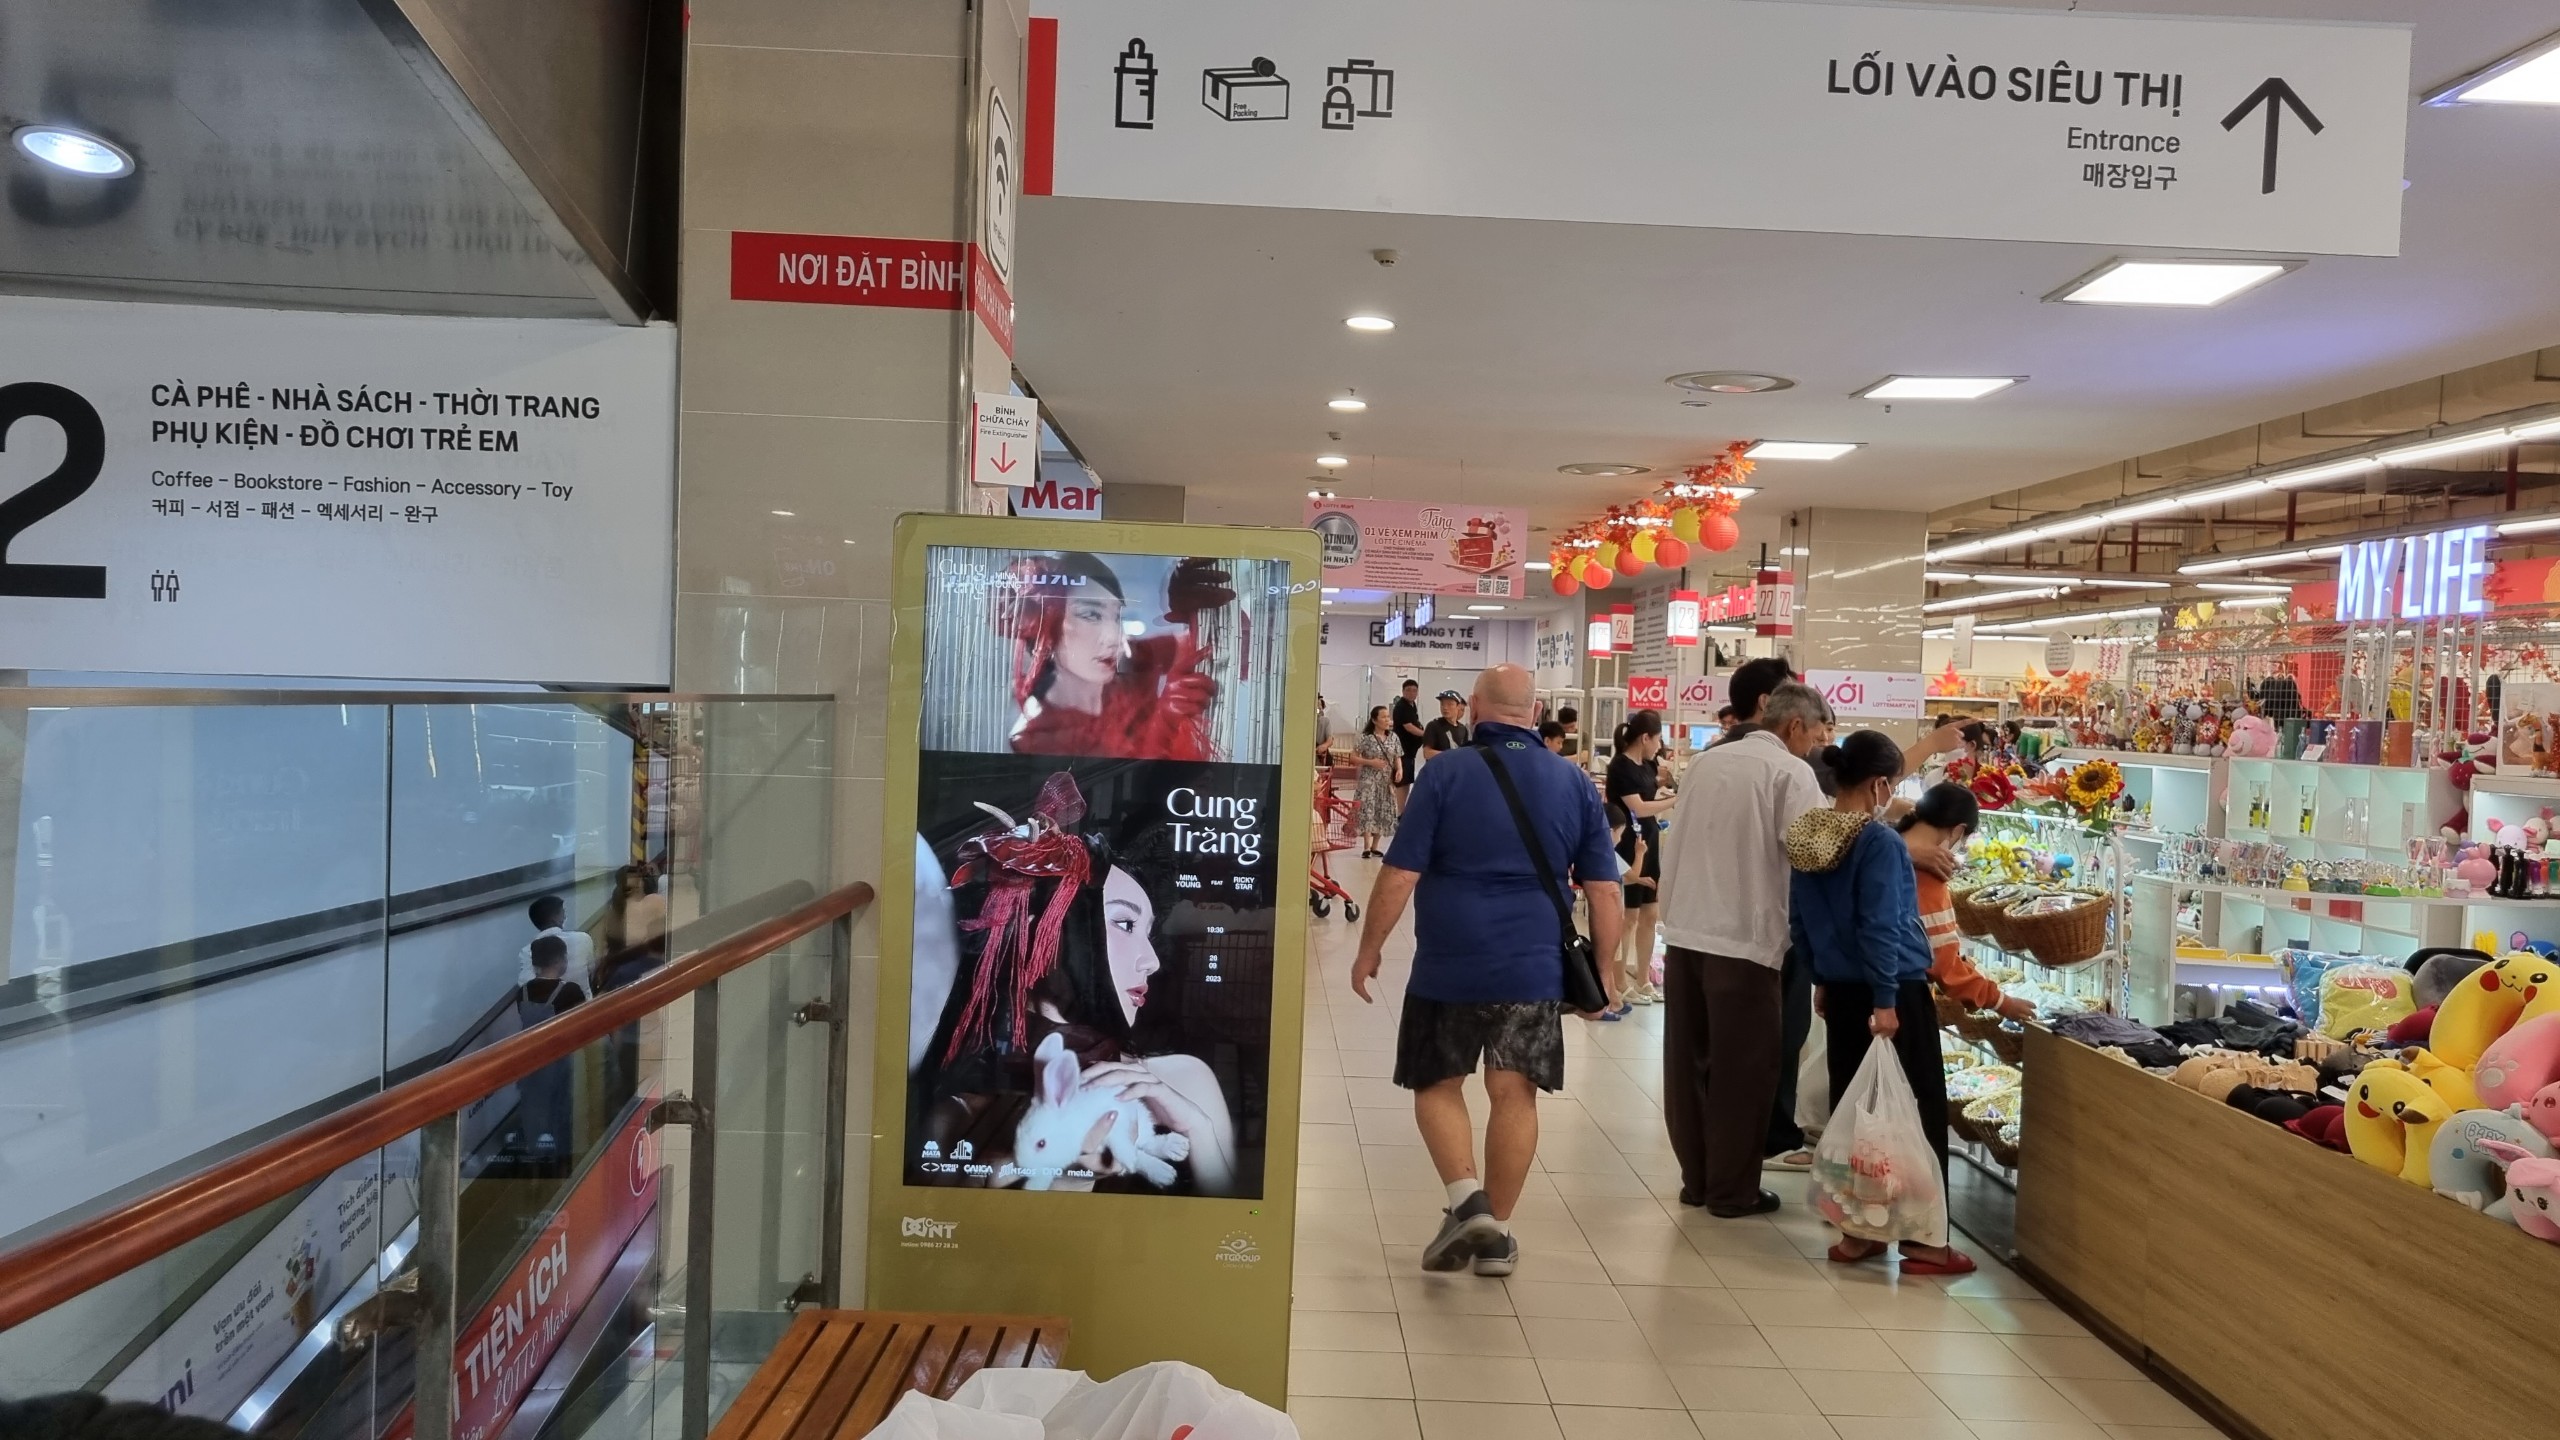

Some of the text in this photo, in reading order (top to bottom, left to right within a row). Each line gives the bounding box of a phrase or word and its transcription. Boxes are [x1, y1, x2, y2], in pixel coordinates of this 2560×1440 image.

[1827, 50, 2183, 118] LỐI VÀO SIÊU THỊ
[2067, 127, 2181, 154] Entrance
[2082, 163, 2178, 191] 매장입구
[779, 251, 964, 295] NƠI ĐẶT BÌNH
[151, 378, 191, 407] CÀ
[197, 381, 251, 409] PHÊ
[272, 383, 331, 411] NHÀ
[337, 384, 412, 413] SÁCH
[433, 387, 498, 416] THỜI
[505, 394, 600, 420] TRANG
[995, 405, 1015, 416] BÌNH
[980, 415, 1030, 427] CHỮA CHÁY
[152, 420, 208, 449] PHỤ
[216, 417, 278, 450] KIỆN
[299, 418, 339, 448] ĐỒ
[346, 426, 413, 450] CHƠI
[421, 423, 471, 451] TRẺ
[479, 430, 519, 452] EM
[0, 381, 107, 599] 2
[151, 470, 213, 488] Coffee
[234, 473, 323, 490] Bookstore
[344, 476, 410, 493] Fashion
[431, 479, 521, 499] Accessory
[541, 481, 573, 501] Toy
[151, 499, 184, 517] 커피
[206, 500, 239, 518] 서점
[261, 502, 295, 520] 패션
[317, 503, 383, 522] 엑세서리
[404, 505, 438, 523] 완구
[1419, 508, 1456, 539] Tặng
[1324, 533, 1354, 545] ATINUM
[1364, 527, 1375, 536] 01
[1391, 529, 1412, 538] XEM
[1413, 530, 1438, 539] PHIM
[1398, 539, 1427, 547] CINEMA
[2336, 525, 2499, 622] MY LIFE
[1760, 590, 1774, 616] 22
[1780, 591, 1791, 617] 22
[1616, 619, 1628, 639] 24
[1679, 607, 1695, 629] 23
[1448, 628, 1456, 638] Y
[1459, 625, 1474, 638] TẾ
[1400, 640, 1480, 651] Health Room 의무실
[1166, 787, 1257, 830] Cung
[1166, 822, 1261, 865] Trăng
[1175, 881, 1201, 889] YOUNG
[1233, 876, 1255, 884] RICKY
[464, 1289, 524, 1399] TIỆN
[528, 1230, 569, 1320] ÍCH
